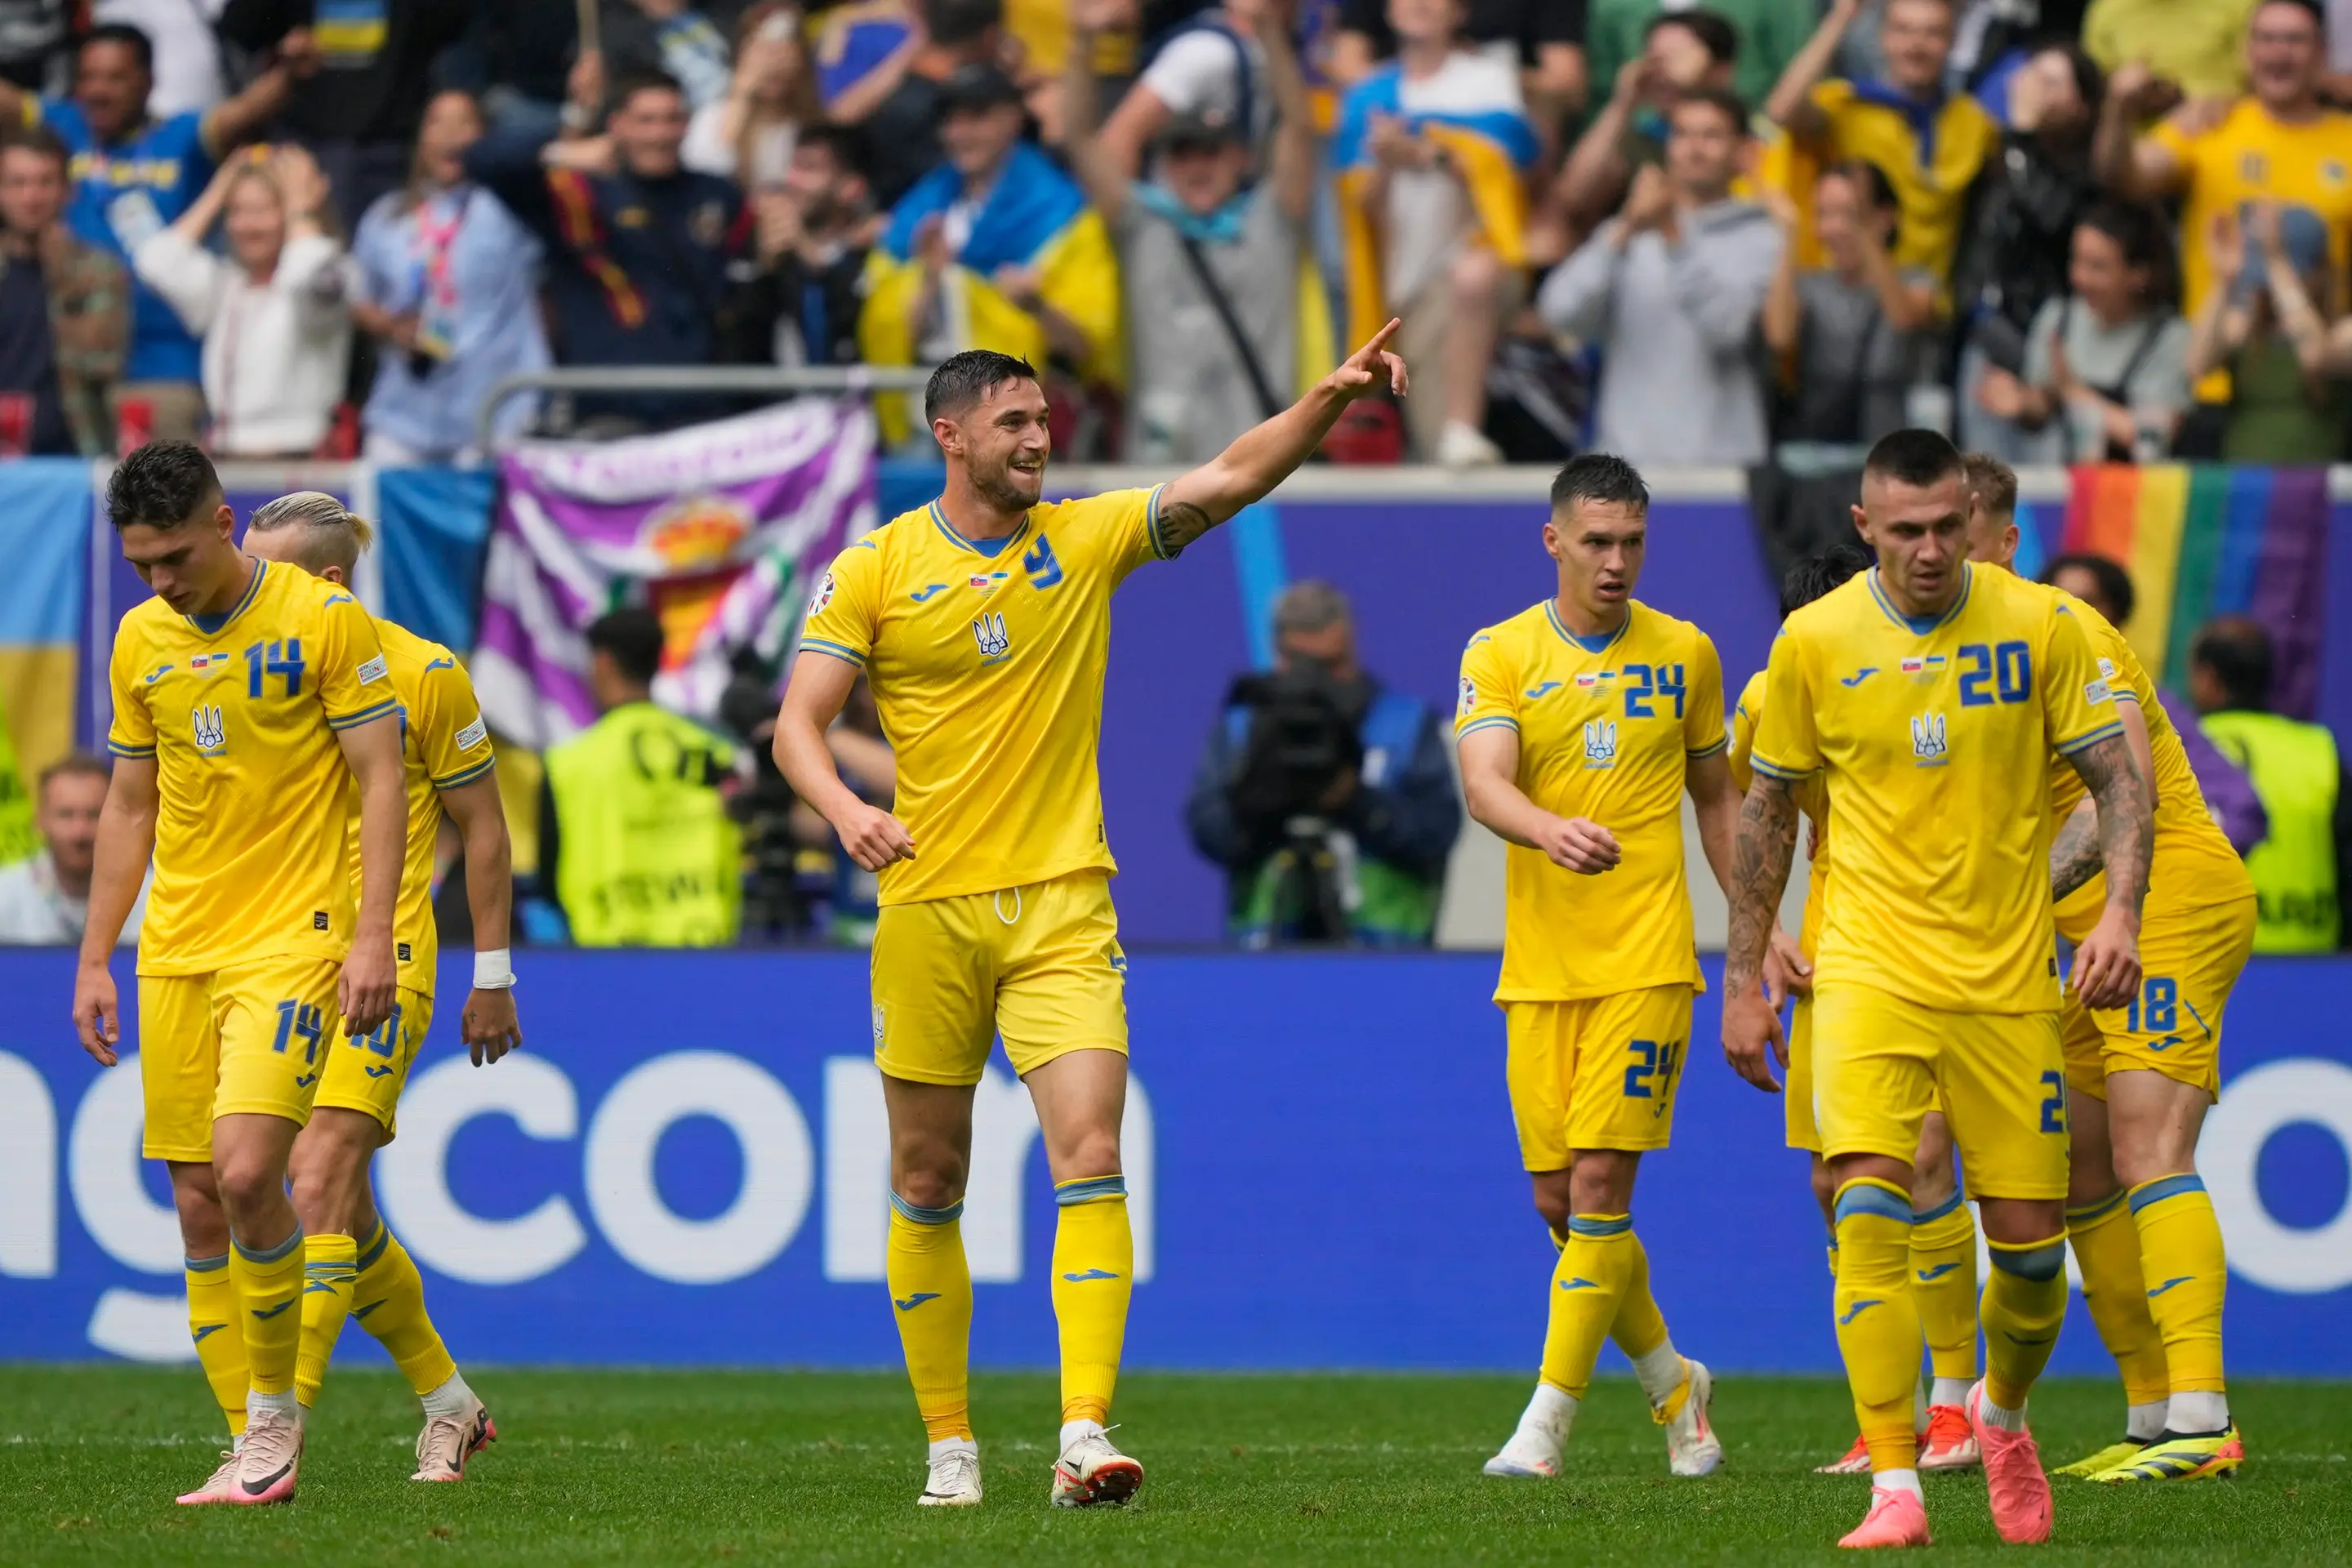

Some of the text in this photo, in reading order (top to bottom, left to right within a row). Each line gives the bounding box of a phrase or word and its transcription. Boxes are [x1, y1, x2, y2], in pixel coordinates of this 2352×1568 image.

[1021, 531, 1064, 591] 9
[243, 638, 305, 699] 14
[1621, 662, 1687, 719] 24
[1958, 640, 2032, 708] 20
[272, 997, 322, 1065] 14
[2126, 976, 2178, 1033] 18
[1623, 1039, 1682, 1099] 24
[2039, 1068, 2070, 1134] 2
